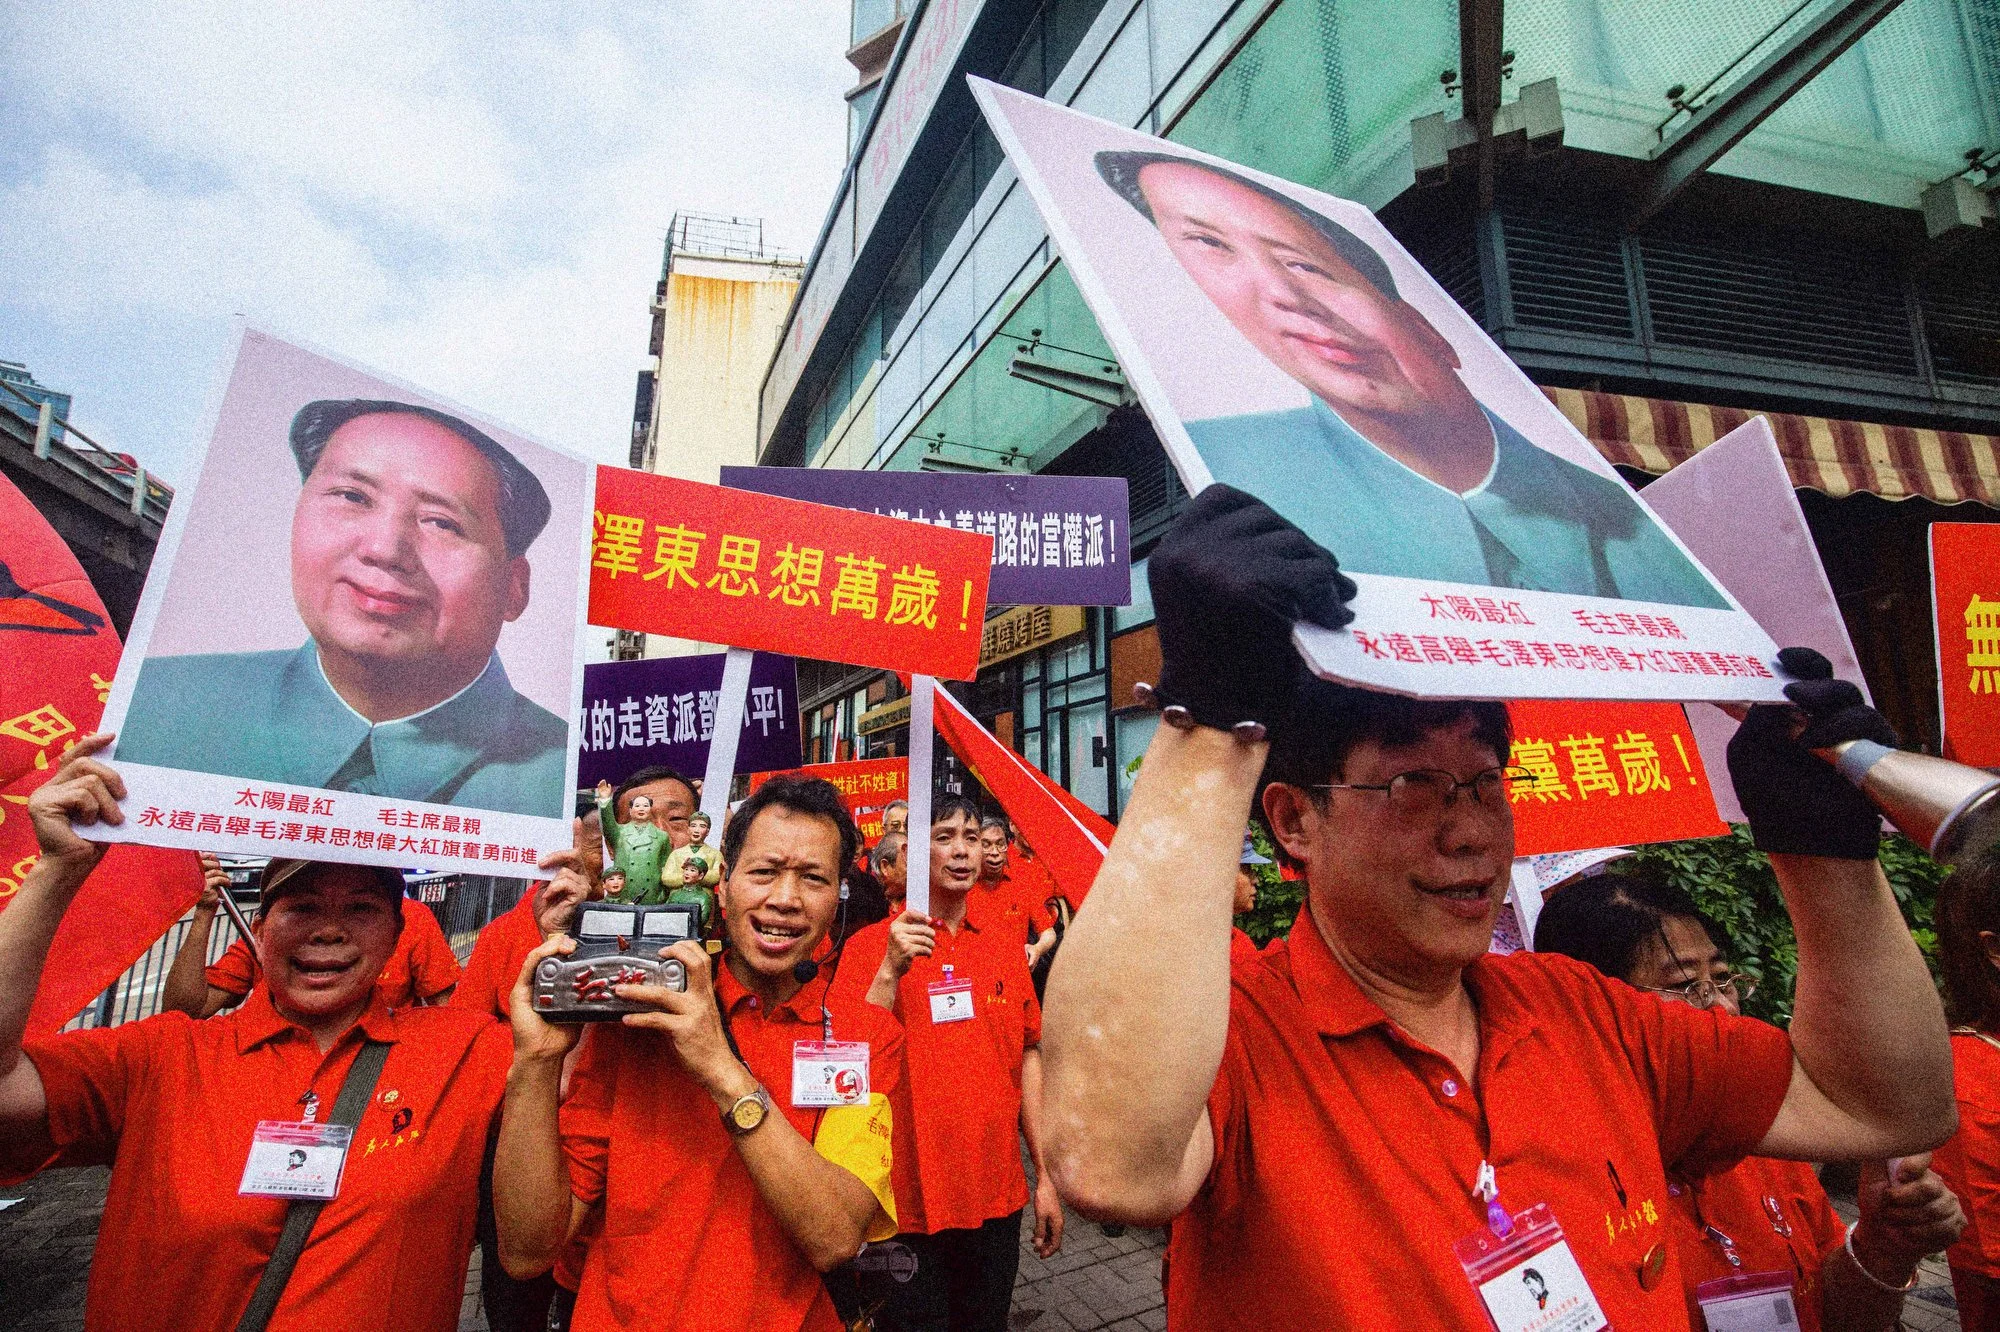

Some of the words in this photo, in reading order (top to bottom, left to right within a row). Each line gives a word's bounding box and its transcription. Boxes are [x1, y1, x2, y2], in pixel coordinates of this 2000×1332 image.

[1418, 591, 1537, 627] 太陽最紅
[1570, 608, 1688, 641] 毛主席最親
[137, 805, 539, 867] 永遠高舉毛澤東思想偉大紅旗奮勇前進
[233, 786, 337, 818] 太陽最紅
[376, 807, 482, 837] 毛主席最親
